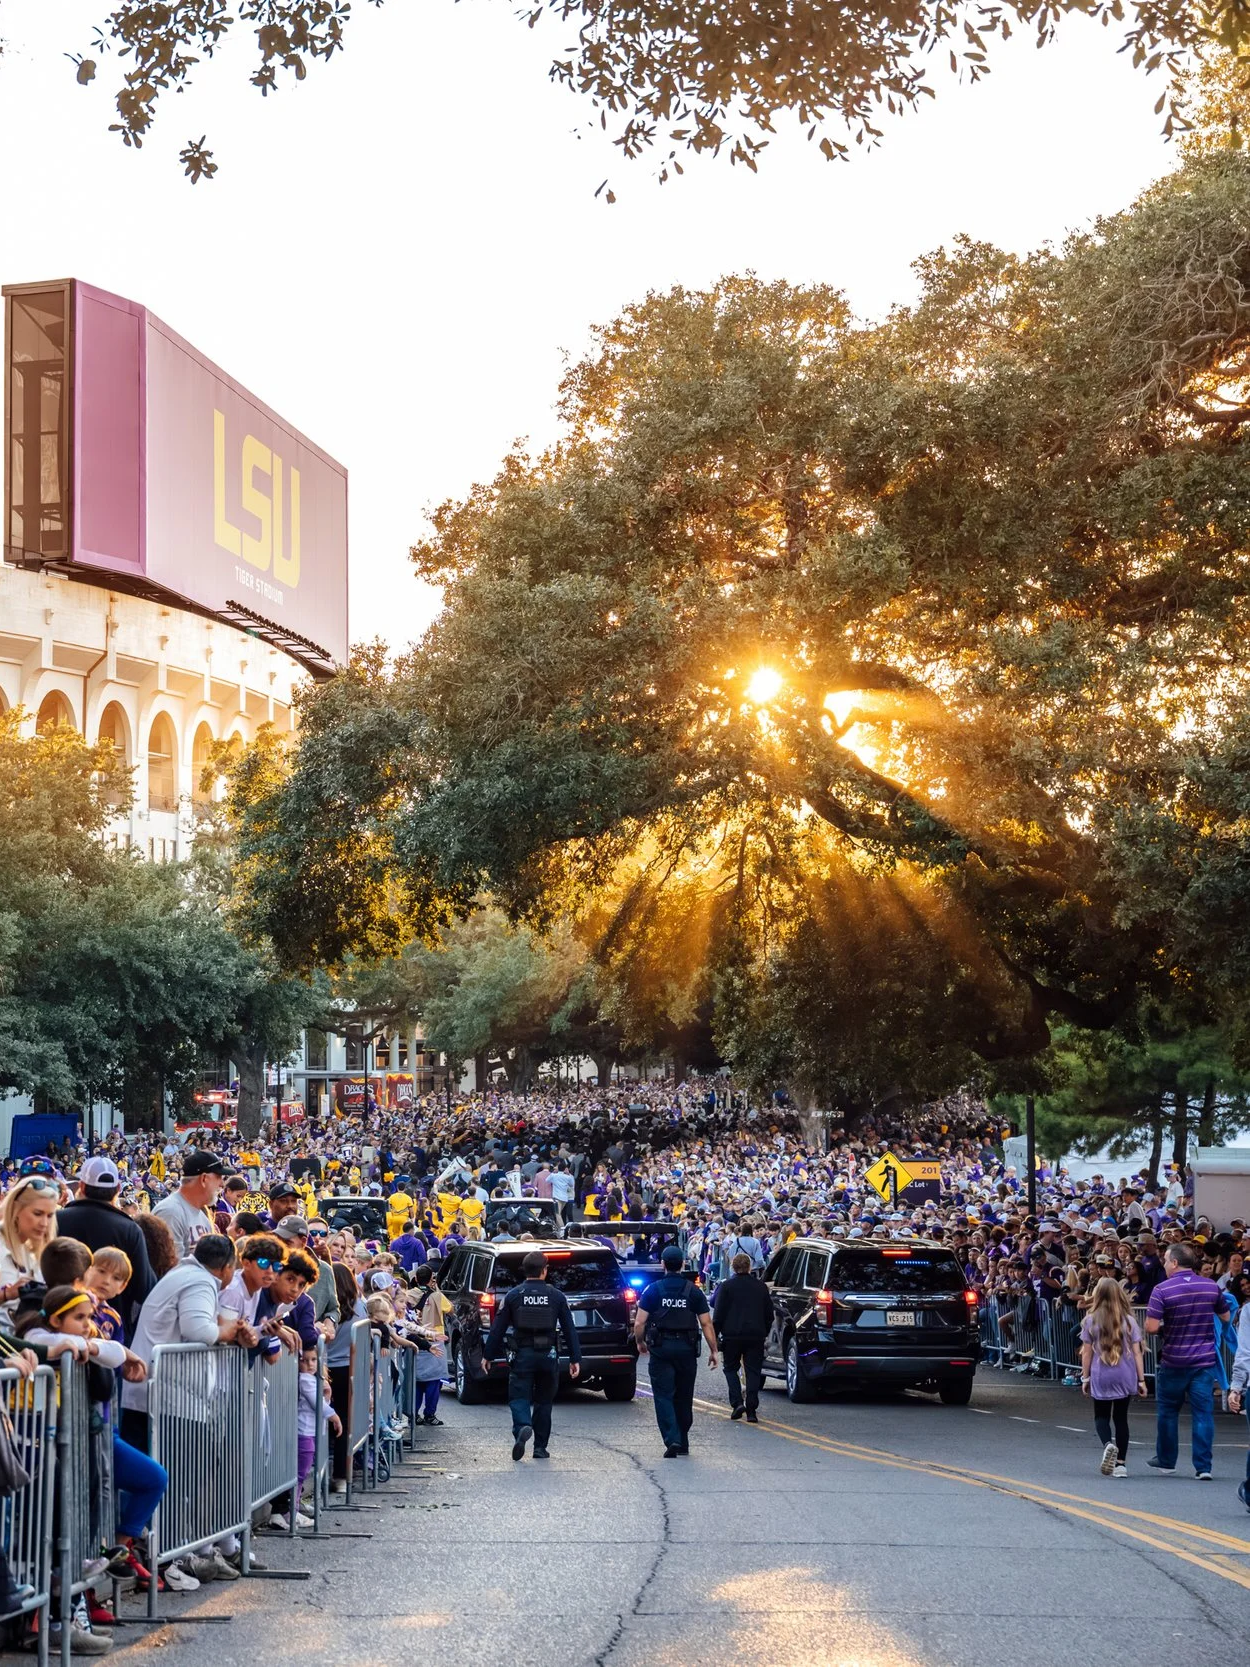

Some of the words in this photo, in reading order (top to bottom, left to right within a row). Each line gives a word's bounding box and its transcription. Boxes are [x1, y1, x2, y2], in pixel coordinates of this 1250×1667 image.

[214, 408, 300, 589] LSU
[235, 566, 254, 589] TIGER
[256, 579, 283, 605] STADIUM
[921, 1166, 937, 1174] 201
[523, 1295, 549, 1305] POLICE
[902, 1315, 913, 1323] 215
